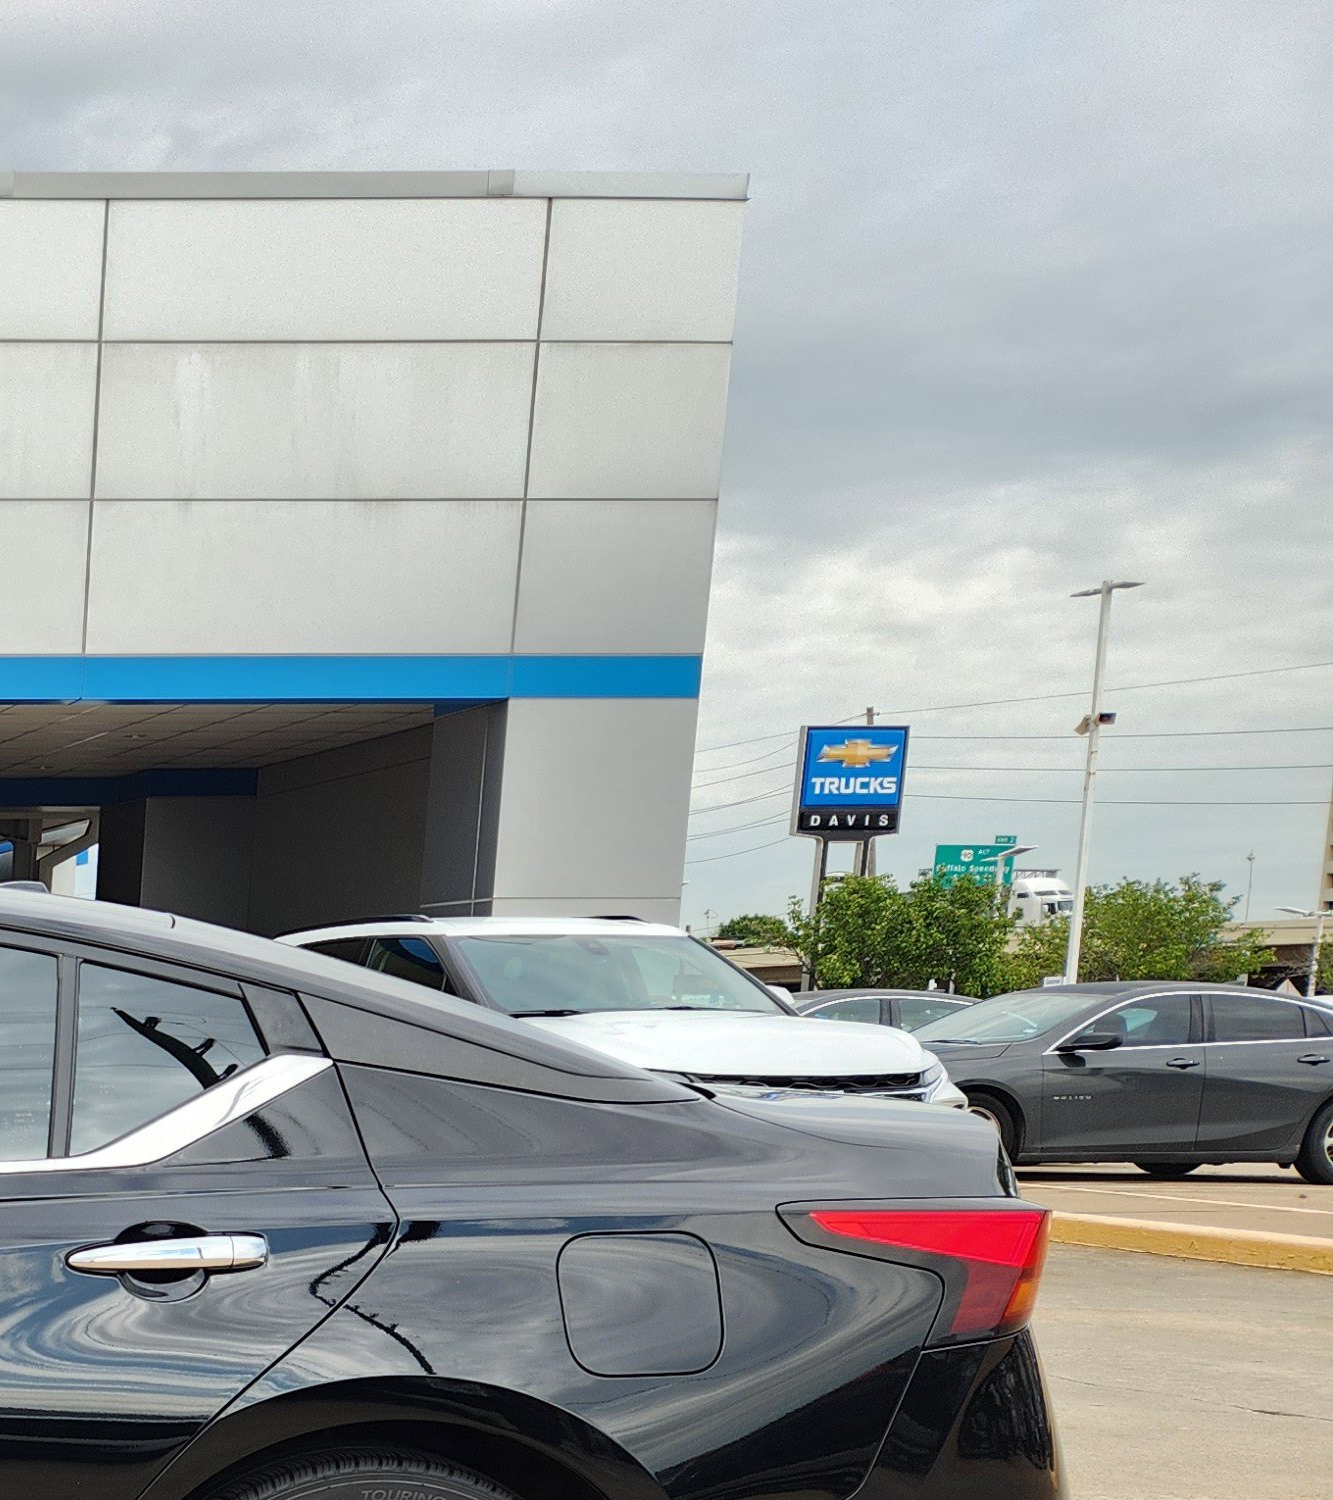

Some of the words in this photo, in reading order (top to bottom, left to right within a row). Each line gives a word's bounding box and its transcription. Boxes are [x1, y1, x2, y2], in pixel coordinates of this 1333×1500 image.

[811, 777, 897, 794] TRUCKS
[810, 814, 889, 827] DAVIS
[969, 864, 1010, 874] Speedy
